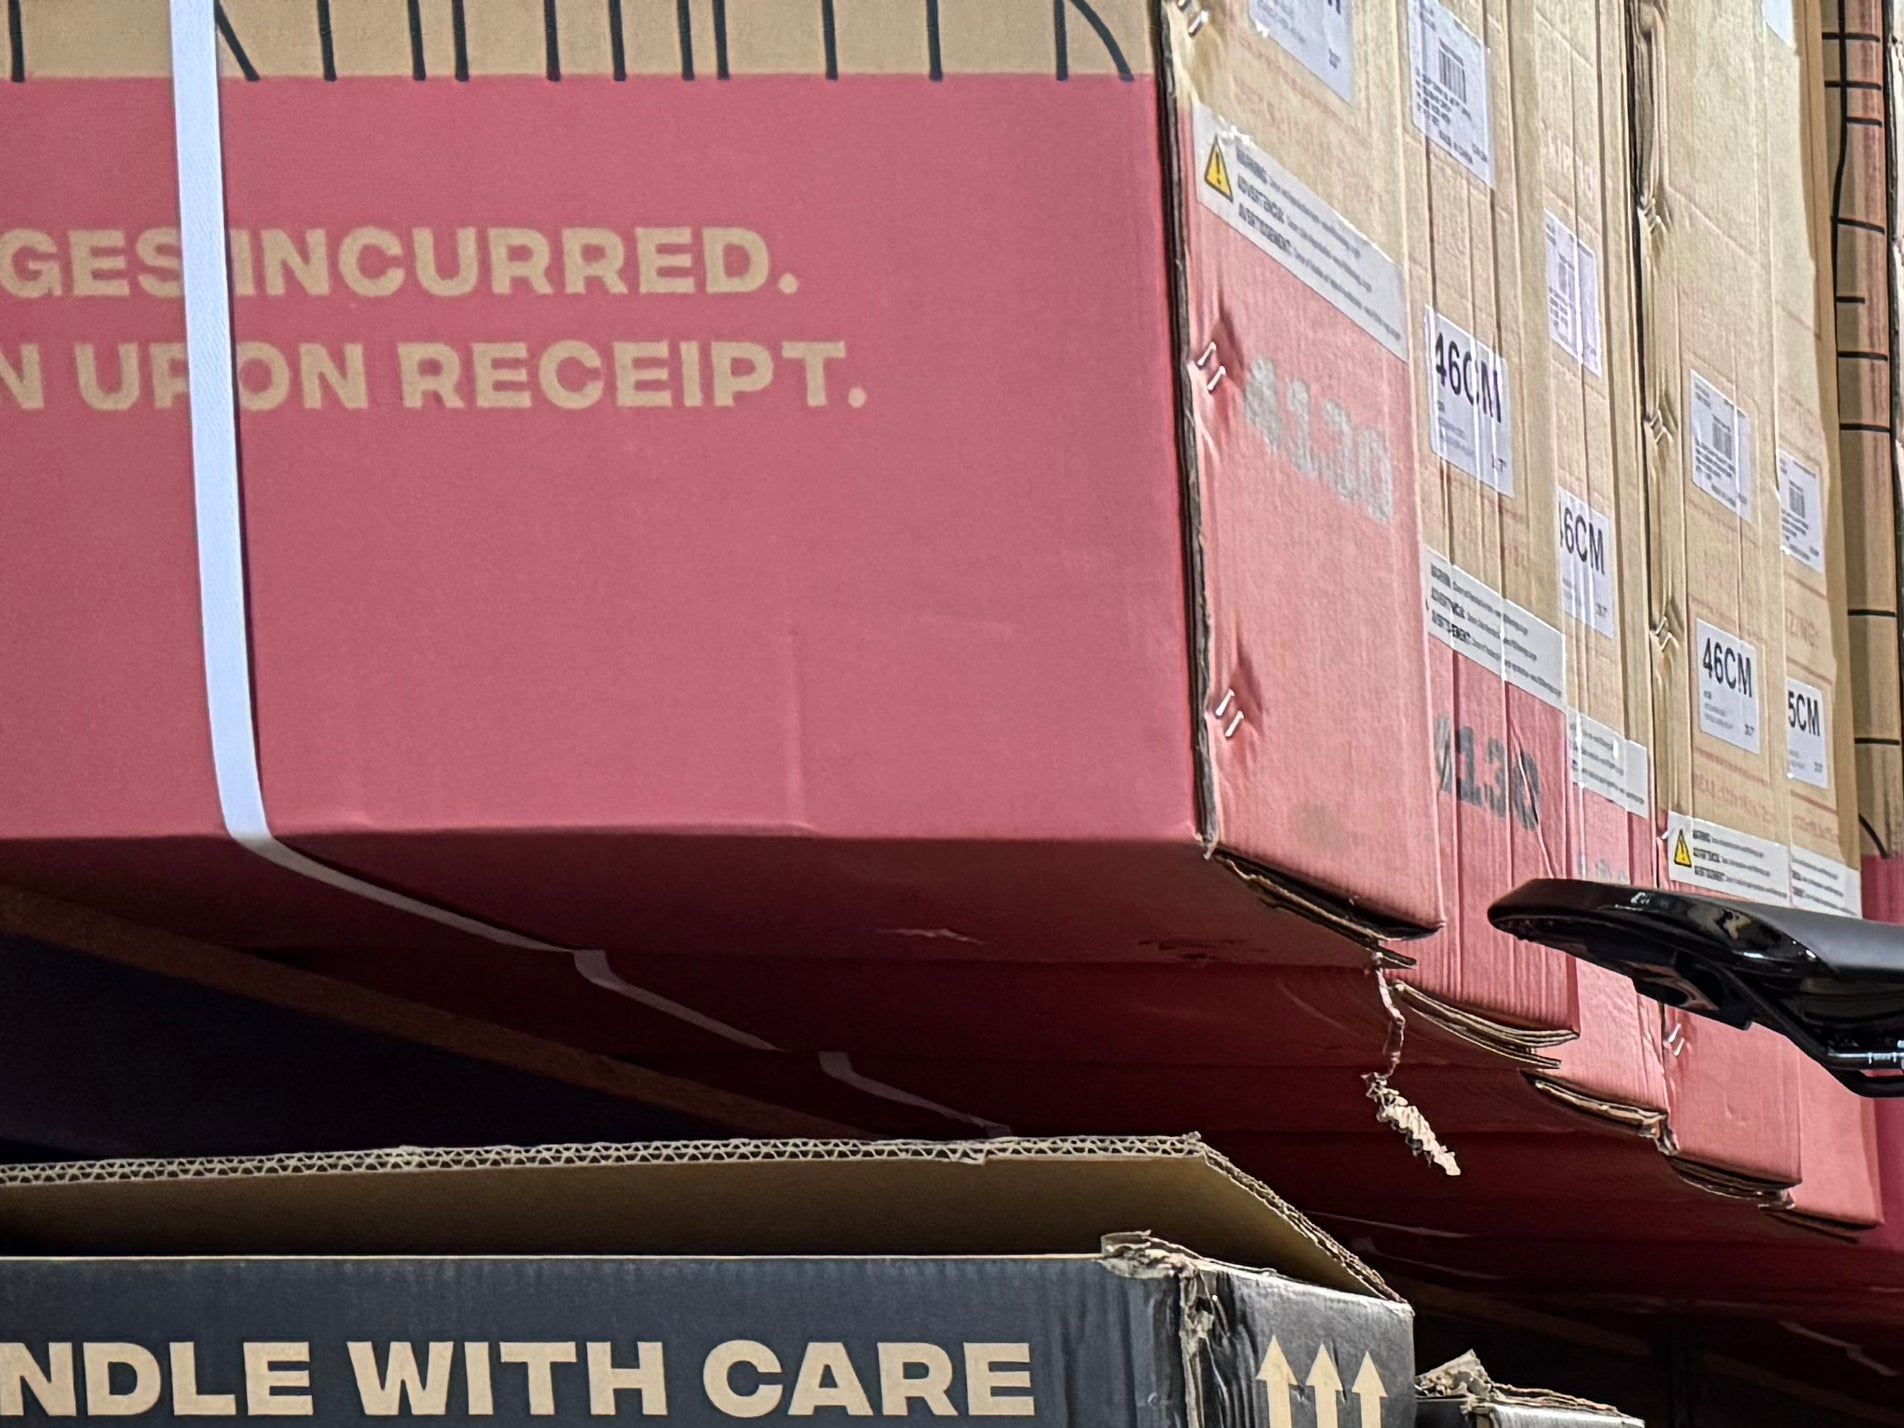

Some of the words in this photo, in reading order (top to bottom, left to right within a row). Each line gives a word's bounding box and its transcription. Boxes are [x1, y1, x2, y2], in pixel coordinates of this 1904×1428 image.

[236, 226, 800, 297] INCURRED.
[399, 340, 868, 409] RECEIPT.
[1559, 503, 1606, 576] 6CM
[1702, 636, 1753, 698] 46CM
[347, 1340, 669, 1416] WITH
[702, 1338, 1037, 1417] CARE
